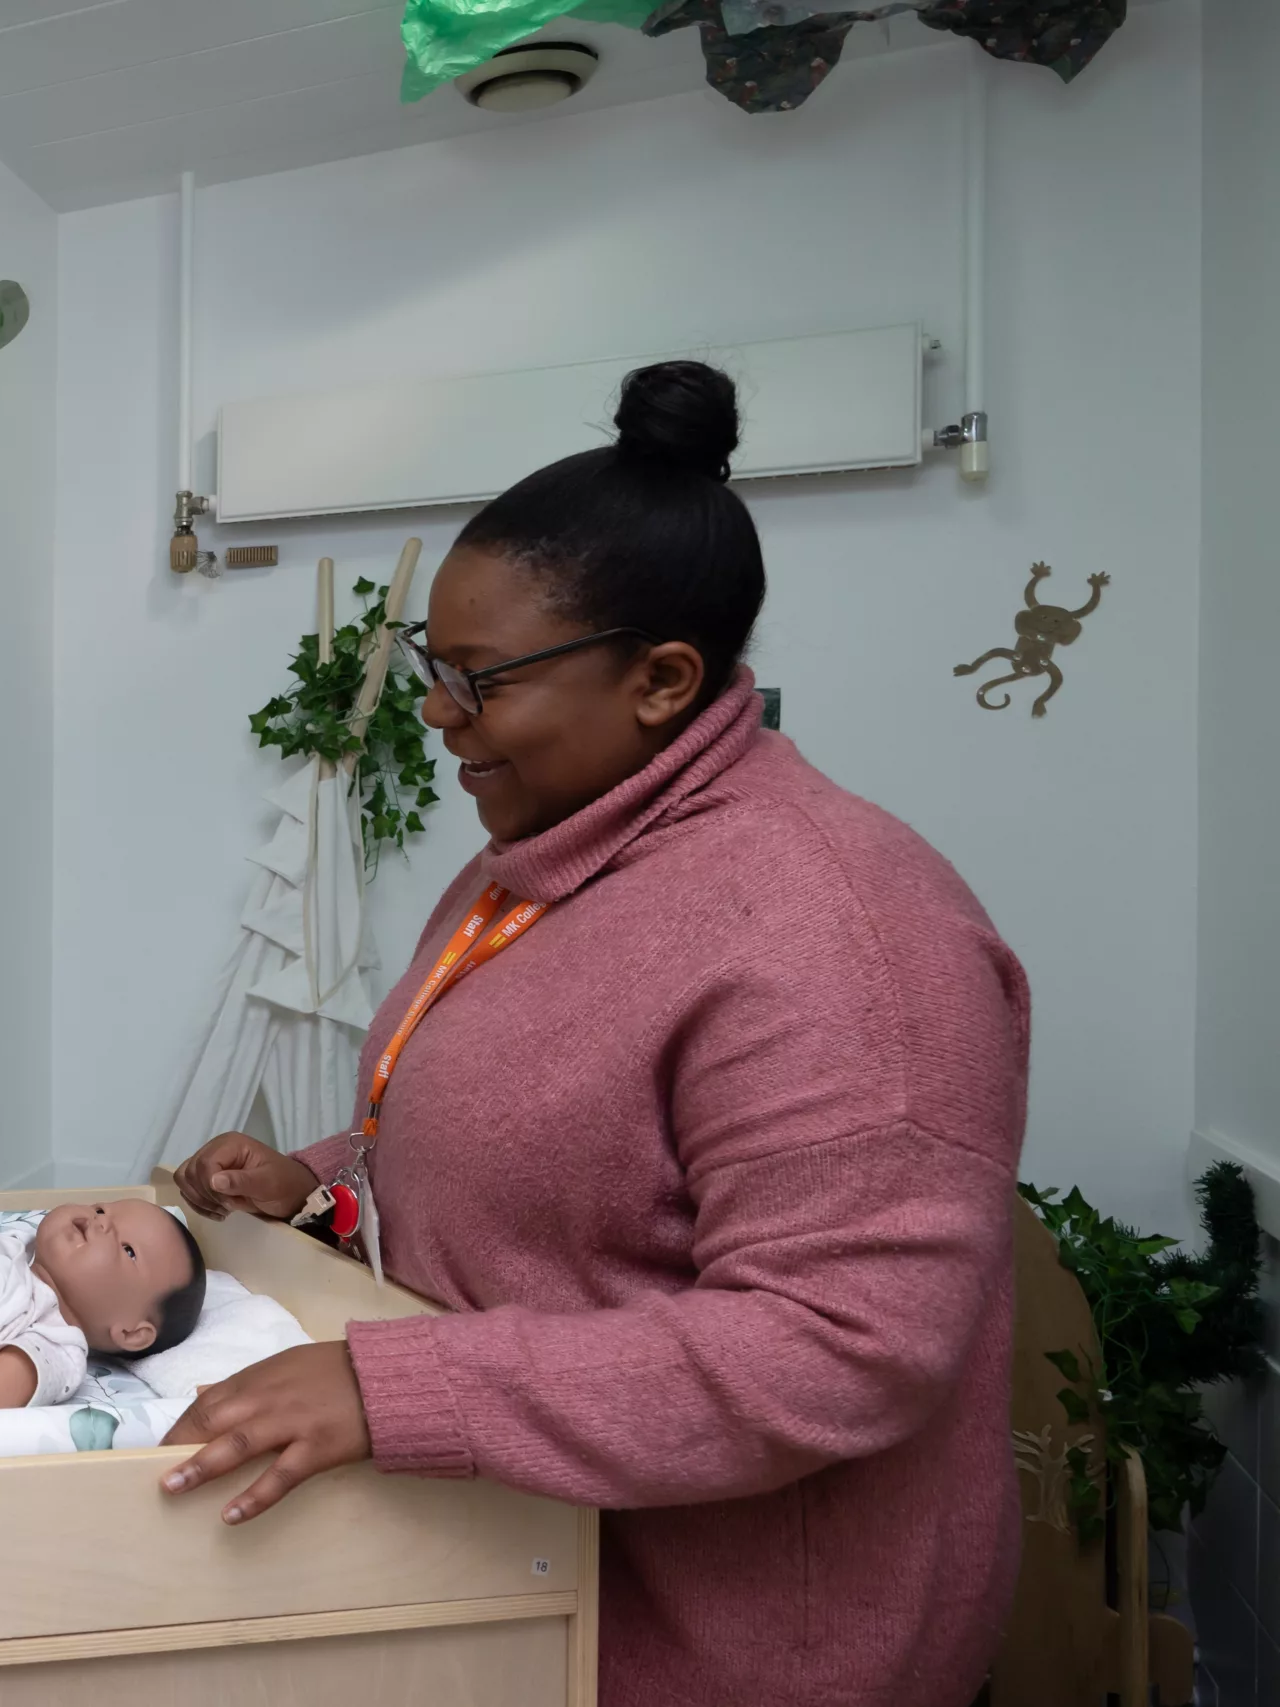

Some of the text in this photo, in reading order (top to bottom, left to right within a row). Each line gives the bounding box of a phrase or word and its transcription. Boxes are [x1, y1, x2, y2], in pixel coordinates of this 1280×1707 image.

[464, 914, 484, 938] Staff
[502, 920, 520, 936] MK
[434, 965, 447, 978] MK
[378, 1054, 392, 1079] Staff
[536, 1561, 548, 1572] 18
